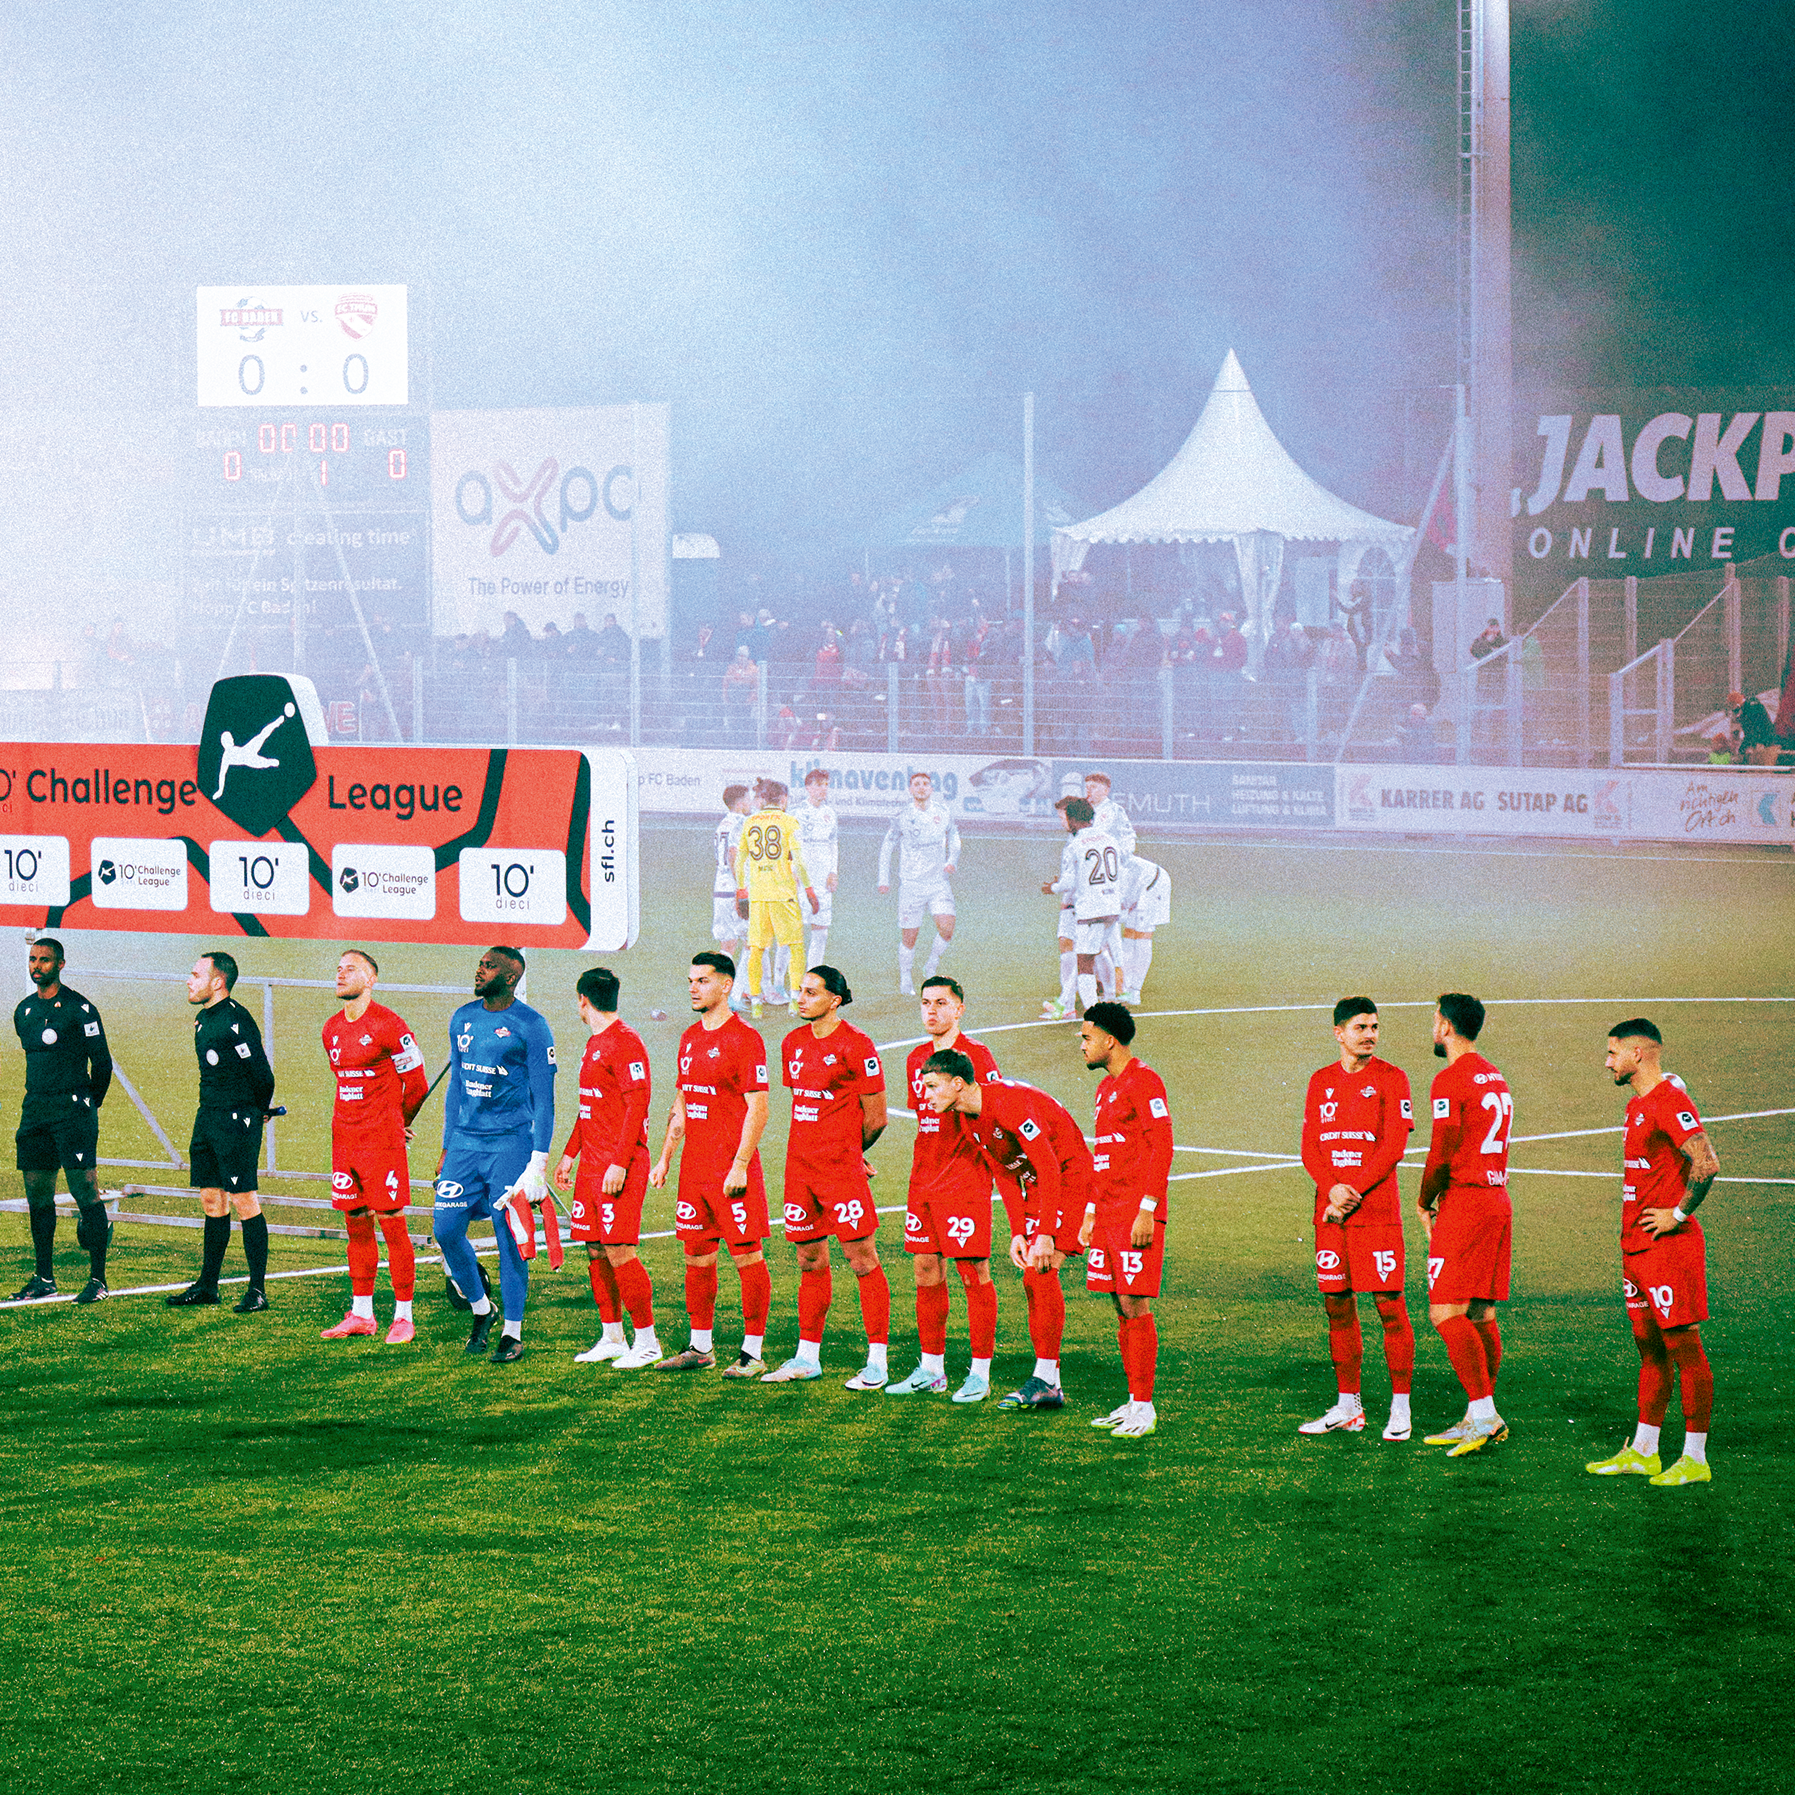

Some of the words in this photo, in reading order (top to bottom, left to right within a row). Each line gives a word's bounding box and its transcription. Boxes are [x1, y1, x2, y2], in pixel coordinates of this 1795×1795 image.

[387, 448, 408, 481] 0
[367, 527, 411, 545] time
[1528, 527, 1735, 559] ONLINE
[467, 577, 496, 596] The
[501, 577, 548, 596] Power
[553, 577, 571, 595] of
[574, 577, 630, 599] Energy
[26, 767, 198, 815] Challenge
[648, 774, 662, 786] FC
[666, 773, 701, 787] Baden
[328, 774, 463, 820] League
[1380, 787, 1454, 811] KARRER
[1460, 789, 1485, 812] AG
[1497, 791, 1557, 813] SUTAP
[1563, 792, 1589, 815] AG
[601, 819, 615, 883] sfl.ch
[748, 824, 782, 861] 38
[138, 865, 181, 878] Challenge
[1085, 845, 1119, 886] 20
[8, 880, 39, 892] dieci
[138, 876, 170, 888] League
[382, 872, 428, 886] Challenge
[243, 888, 276, 901] dieci
[382, 885, 417, 897] League
[495, 897, 531, 910] dieci
[1480, 1091, 1514, 1155] 27
[385, 1170, 399, 1189] 4
[601, 1202, 615, 1222] 3
[731, 1202, 747, 1222] 5
[833, 1199, 865, 1224] 28
[946, 1216, 975, 1238] 29
[1119, 1251, 1144, 1274] 13
[1372, 1250, 1397, 1273] 15
[1649, 1284, 1674, 1309] 10
